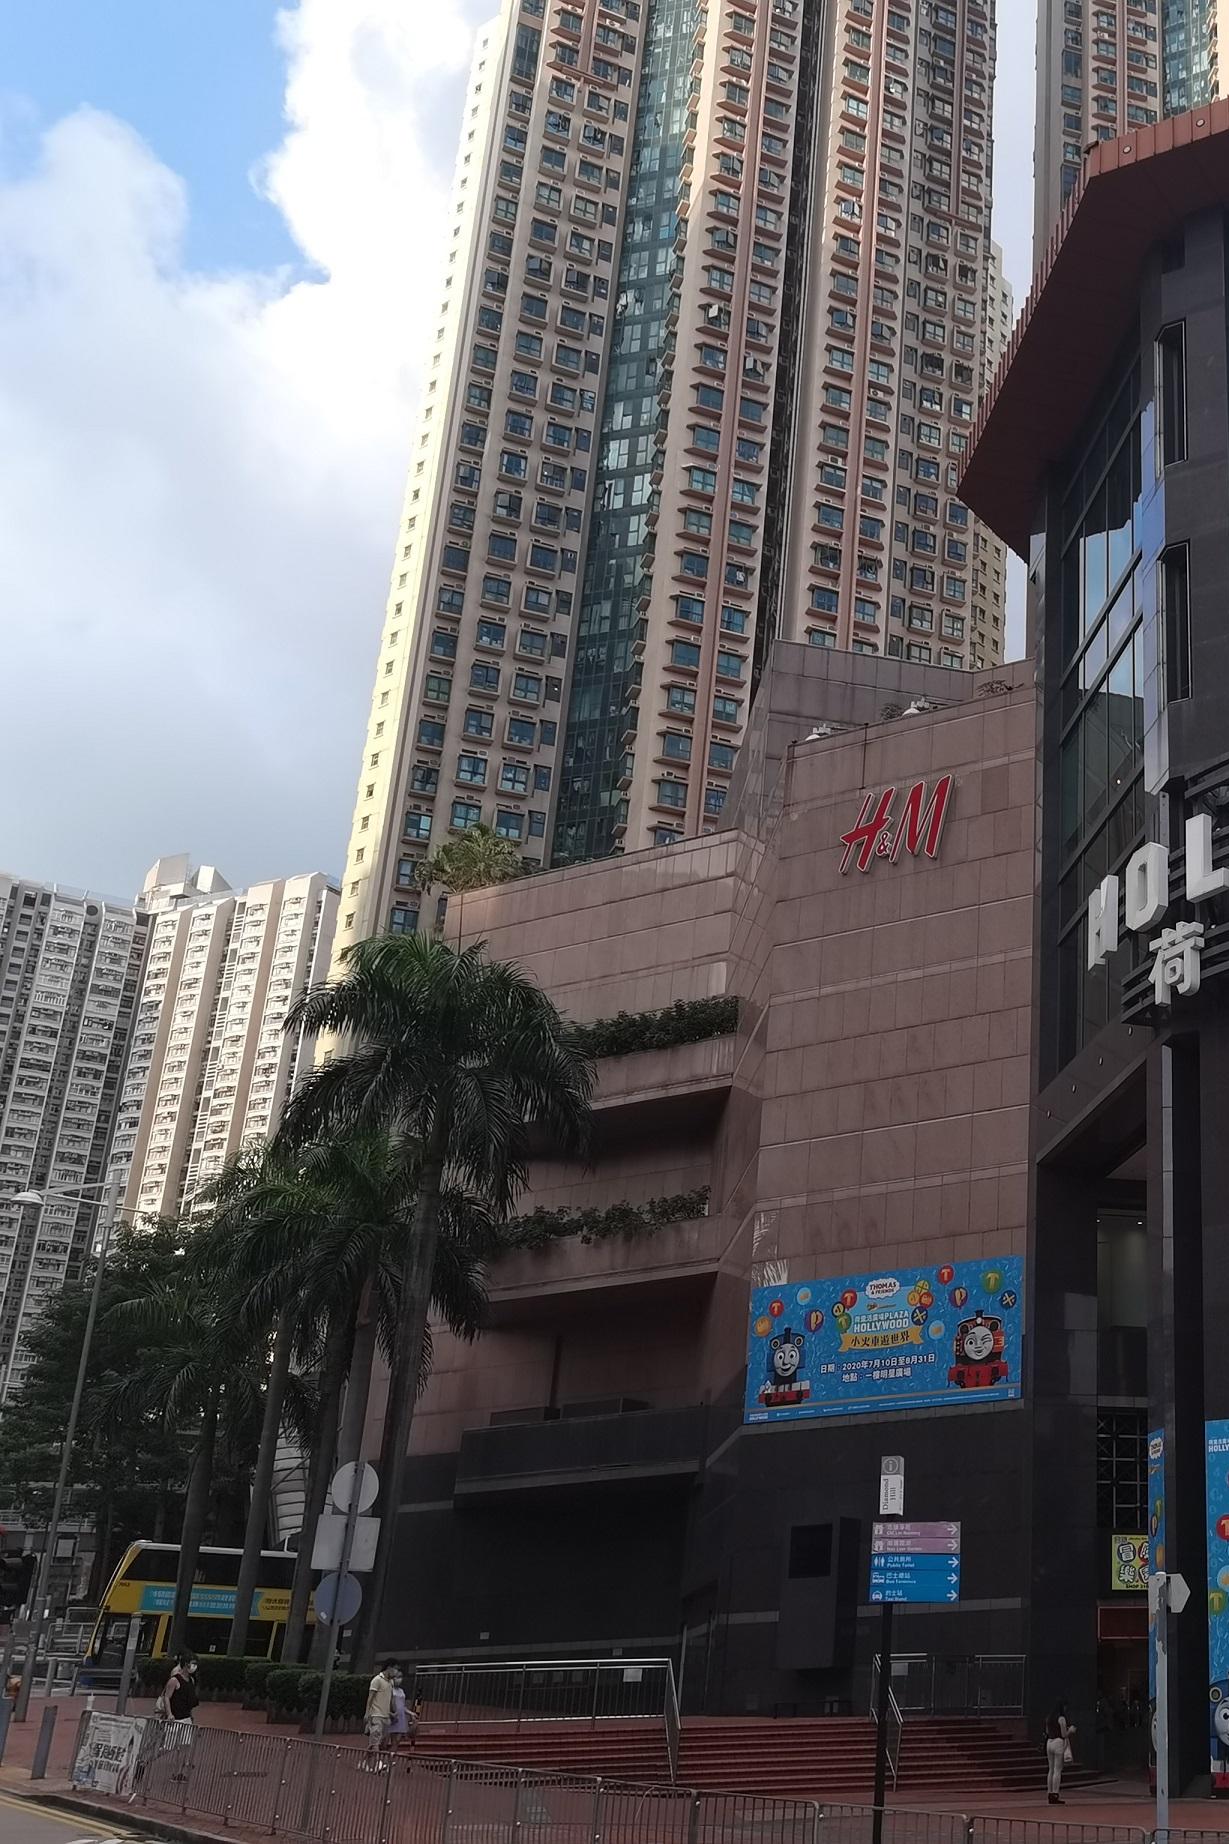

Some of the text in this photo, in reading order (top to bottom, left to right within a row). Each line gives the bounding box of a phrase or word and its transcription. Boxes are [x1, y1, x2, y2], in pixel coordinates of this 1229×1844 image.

[838, 773, 955, 875] H&M
[870, 1282, 897, 1291] THOMAS
[853, 1319, 909, 1333] HOLLYWOOD
